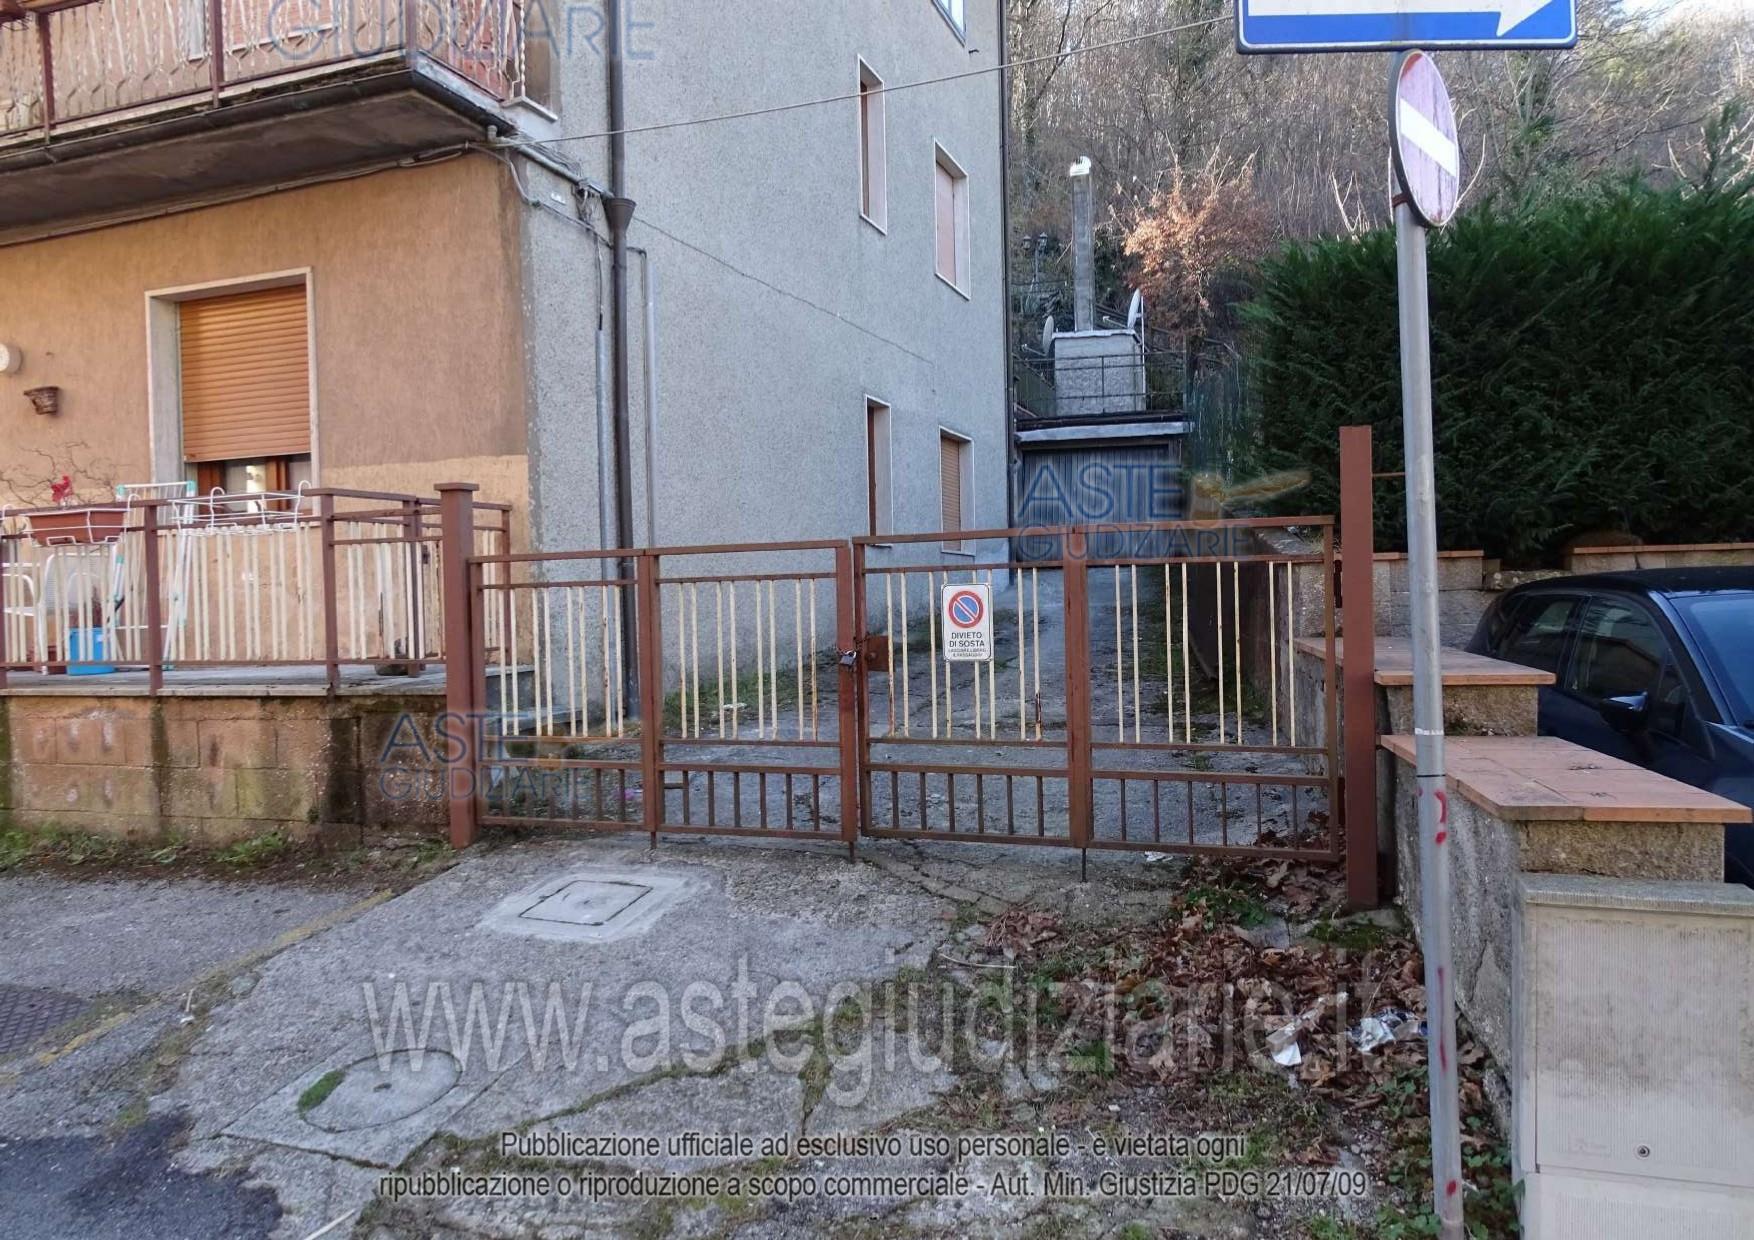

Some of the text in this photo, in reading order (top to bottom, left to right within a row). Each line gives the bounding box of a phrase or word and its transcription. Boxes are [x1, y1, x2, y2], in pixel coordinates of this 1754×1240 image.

[951, 631, 982, 639] DIVIETO
[949, 640, 985, 648] DI SOSTA
